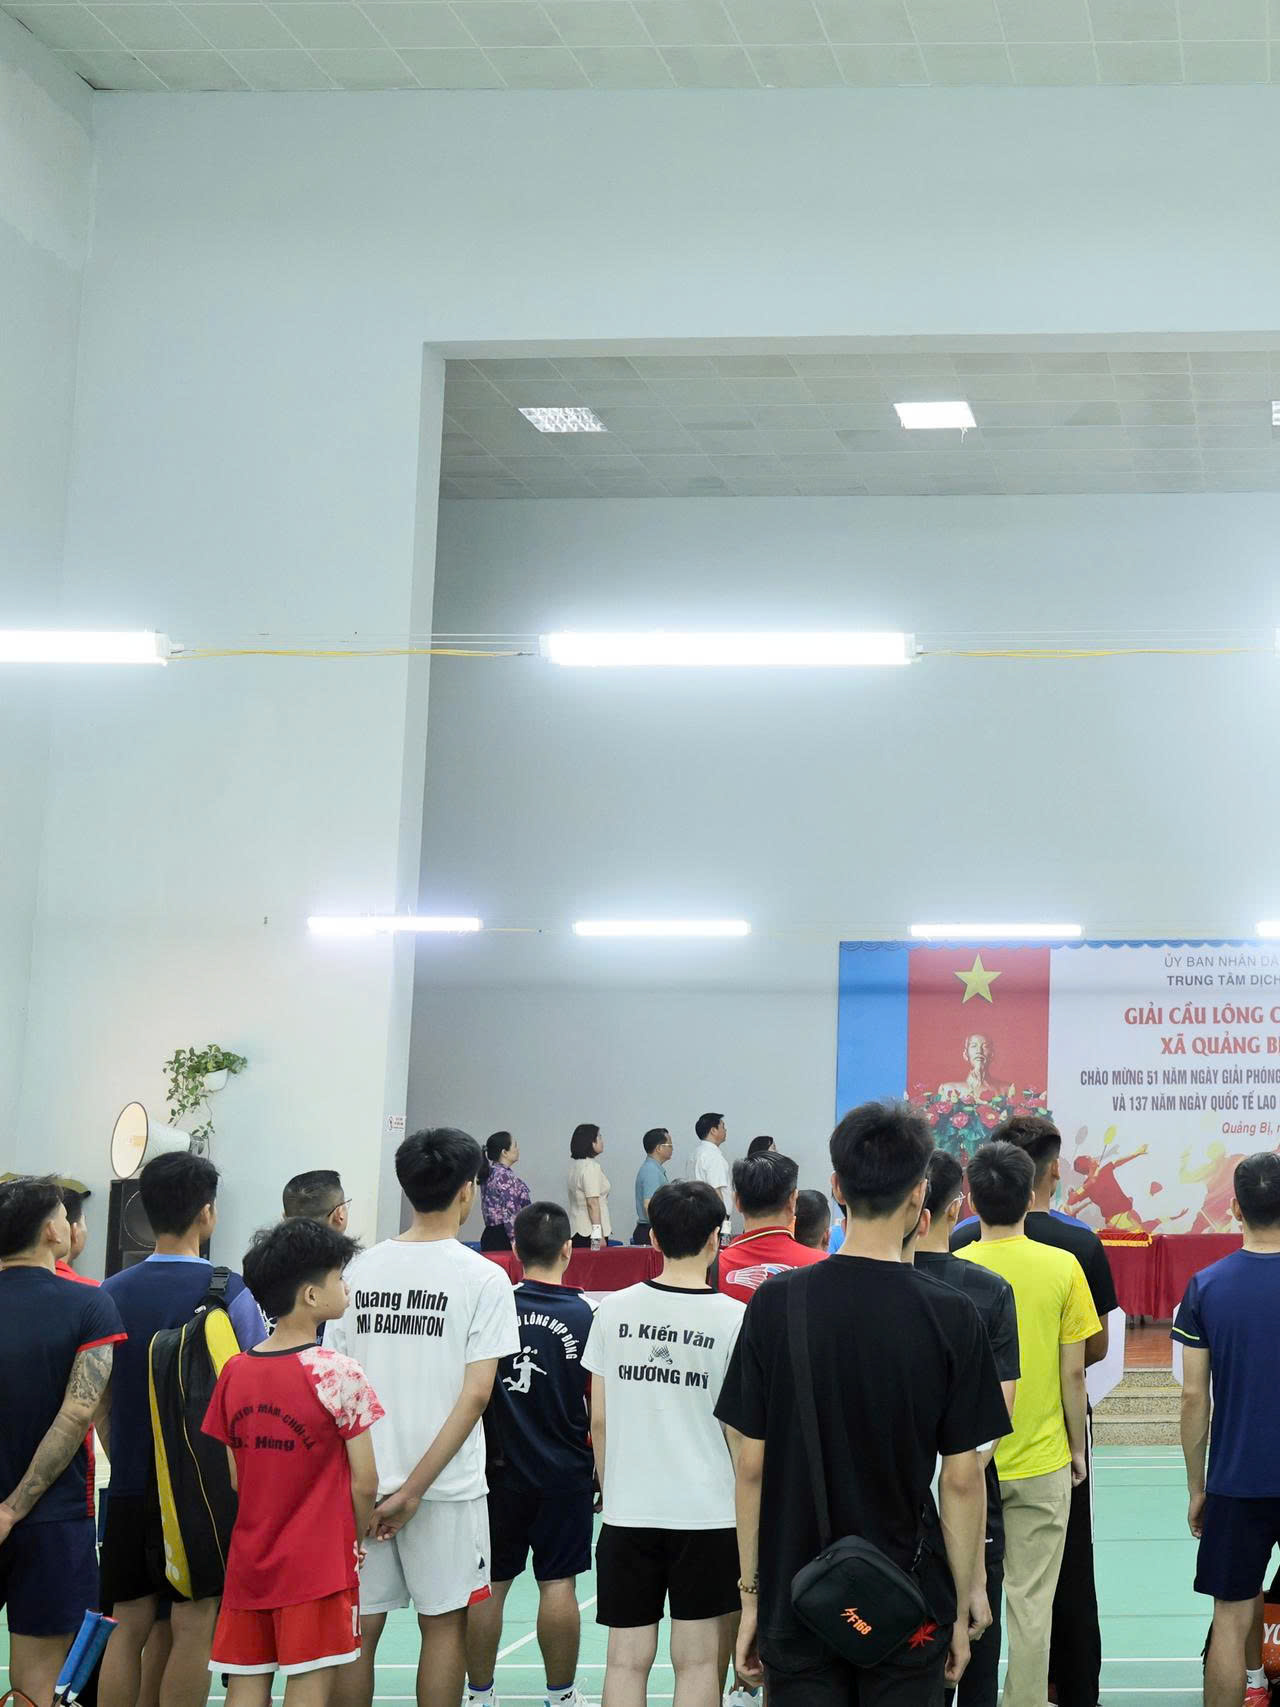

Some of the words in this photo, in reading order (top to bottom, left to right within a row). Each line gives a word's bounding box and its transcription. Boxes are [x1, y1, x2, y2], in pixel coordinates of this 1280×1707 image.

[1186, 957, 1213, 967] BAN
[1167, 975, 1213, 986] TRUNG
[1218, 971, 1246, 986] TÂM
[1124, 1001, 1163, 1024] GIẢI
[1169, 1001, 1206, 1024] CẦU
[1213, 1002, 1264, 1024] LÔNG
[1161, 1033, 1186, 1055] XÃ
[1192, 1031, 1260, 1056] QUẢNG
[1080, 1067, 1109, 1086] CHÀO
[1112, 1067, 1144, 1085] MỪNG
[1147, 1070, 1159, 1085] 51
[1162, 1067, 1187, 1085] NĂM
[1191, 1066, 1219, 1084] NGÀY
[1222, 1064, 1243, 1084] GIẢI
[1112, 1093, 1126, 1111] VÀ
[1129, 1096, 1148, 1111] 137
[1151, 1093, 1176, 1110] NĂM
[1179, 1092, 1207, 1111] NGÀY
[1211, 1090, 1239, 1111] QUỐC
[1242, 1090, 1254, 1110] TẾ
[1257, 1095, 1276, 1110] LAO
[1222, 1121, 1256, 1136] Quảng
[1260, 1122, 1273, 1136] Bị,
[355, 1290, 402, 1311] Quang
[407, 1290, 448, 1312] Minh
[374, 1314, 444, 1337] BADMINTON
[524, 1312, 550, 1327] LÔNG
[548, 1319, 568, 1335] HỢP
[619, 1324, 632, 1338] Đ.
[638, 1324, 678, 1343] Kiến
[683, 1329, 716, 1350] Văn
